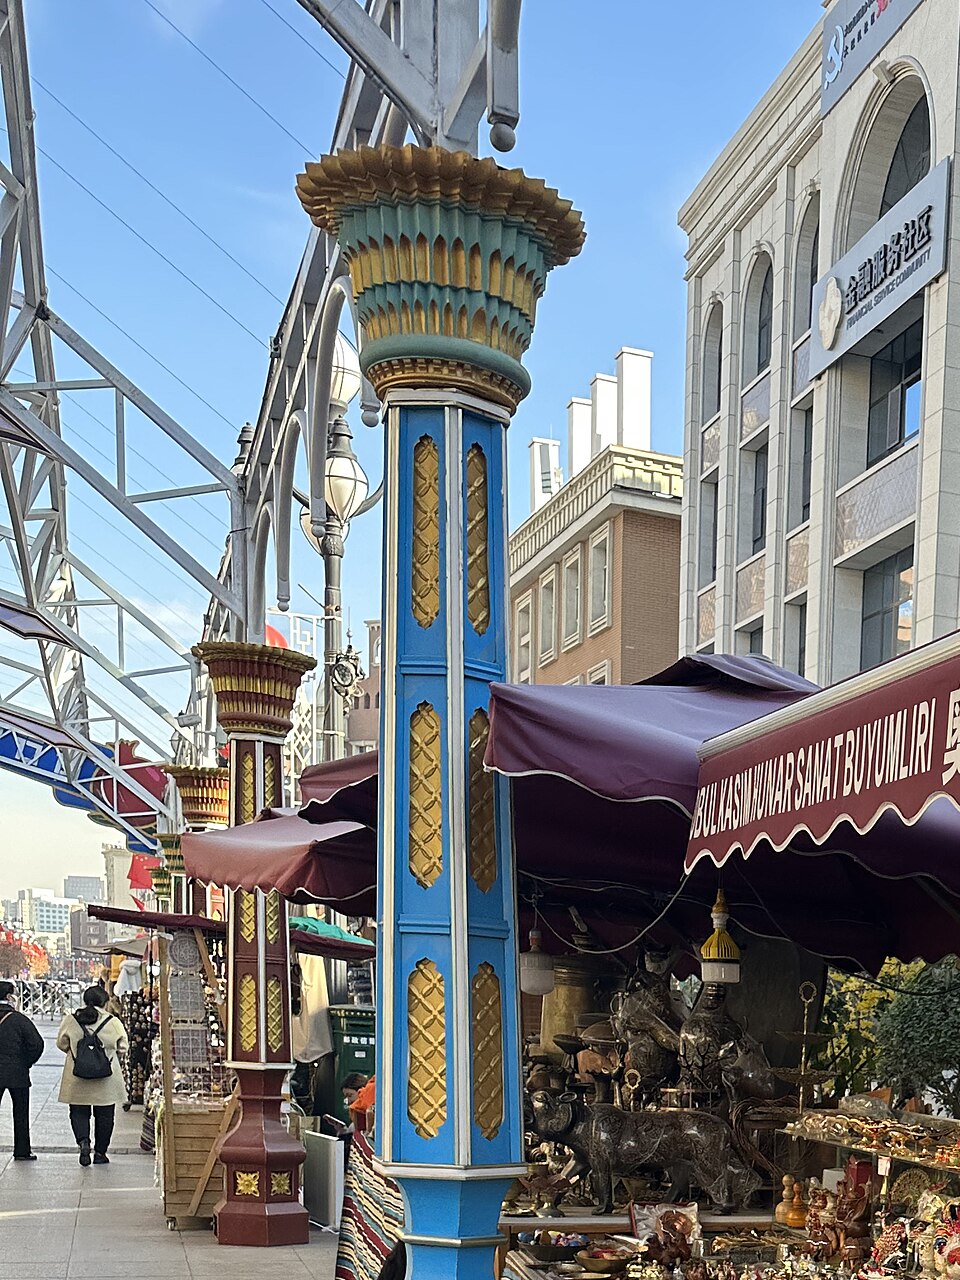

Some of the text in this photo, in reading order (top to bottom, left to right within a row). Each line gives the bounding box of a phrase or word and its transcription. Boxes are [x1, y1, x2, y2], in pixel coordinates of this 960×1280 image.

[845, 205, 933, 314] 金融服务社区
[846, 247, 932, 331] FINANCIAL SERVICE COMMUNITY
[795, 733, 844, 811] SANAT
[843, 697, 937, 797] BUYUMLIRI
